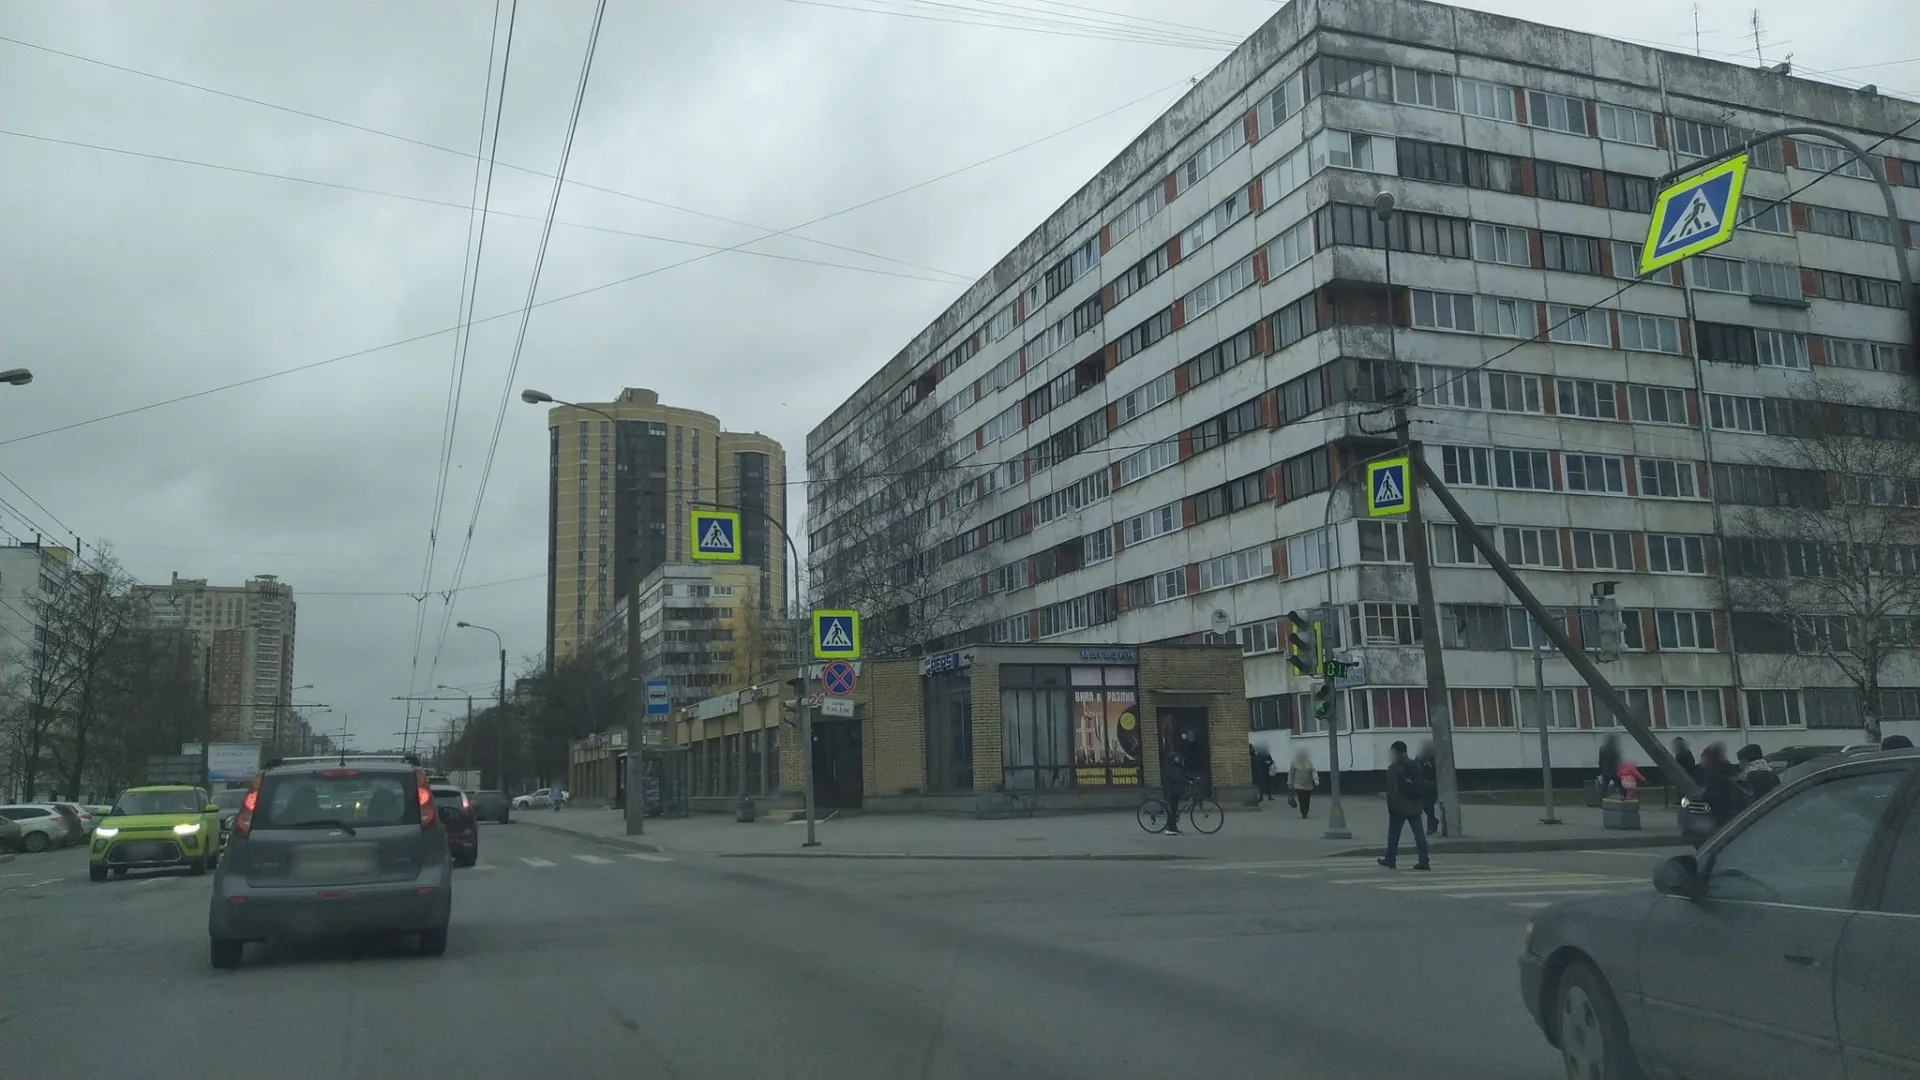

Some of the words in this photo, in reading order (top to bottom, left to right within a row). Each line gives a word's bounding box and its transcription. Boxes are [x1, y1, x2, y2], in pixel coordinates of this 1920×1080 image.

[1080, 650, 1134, 661] МАГАЗИН
[1075, 692, 1095, 702] ВИНА
[1107, 691, 1135, 702] РАЗЛИВ
[1112, 777, 1138, 785] ПИВО
